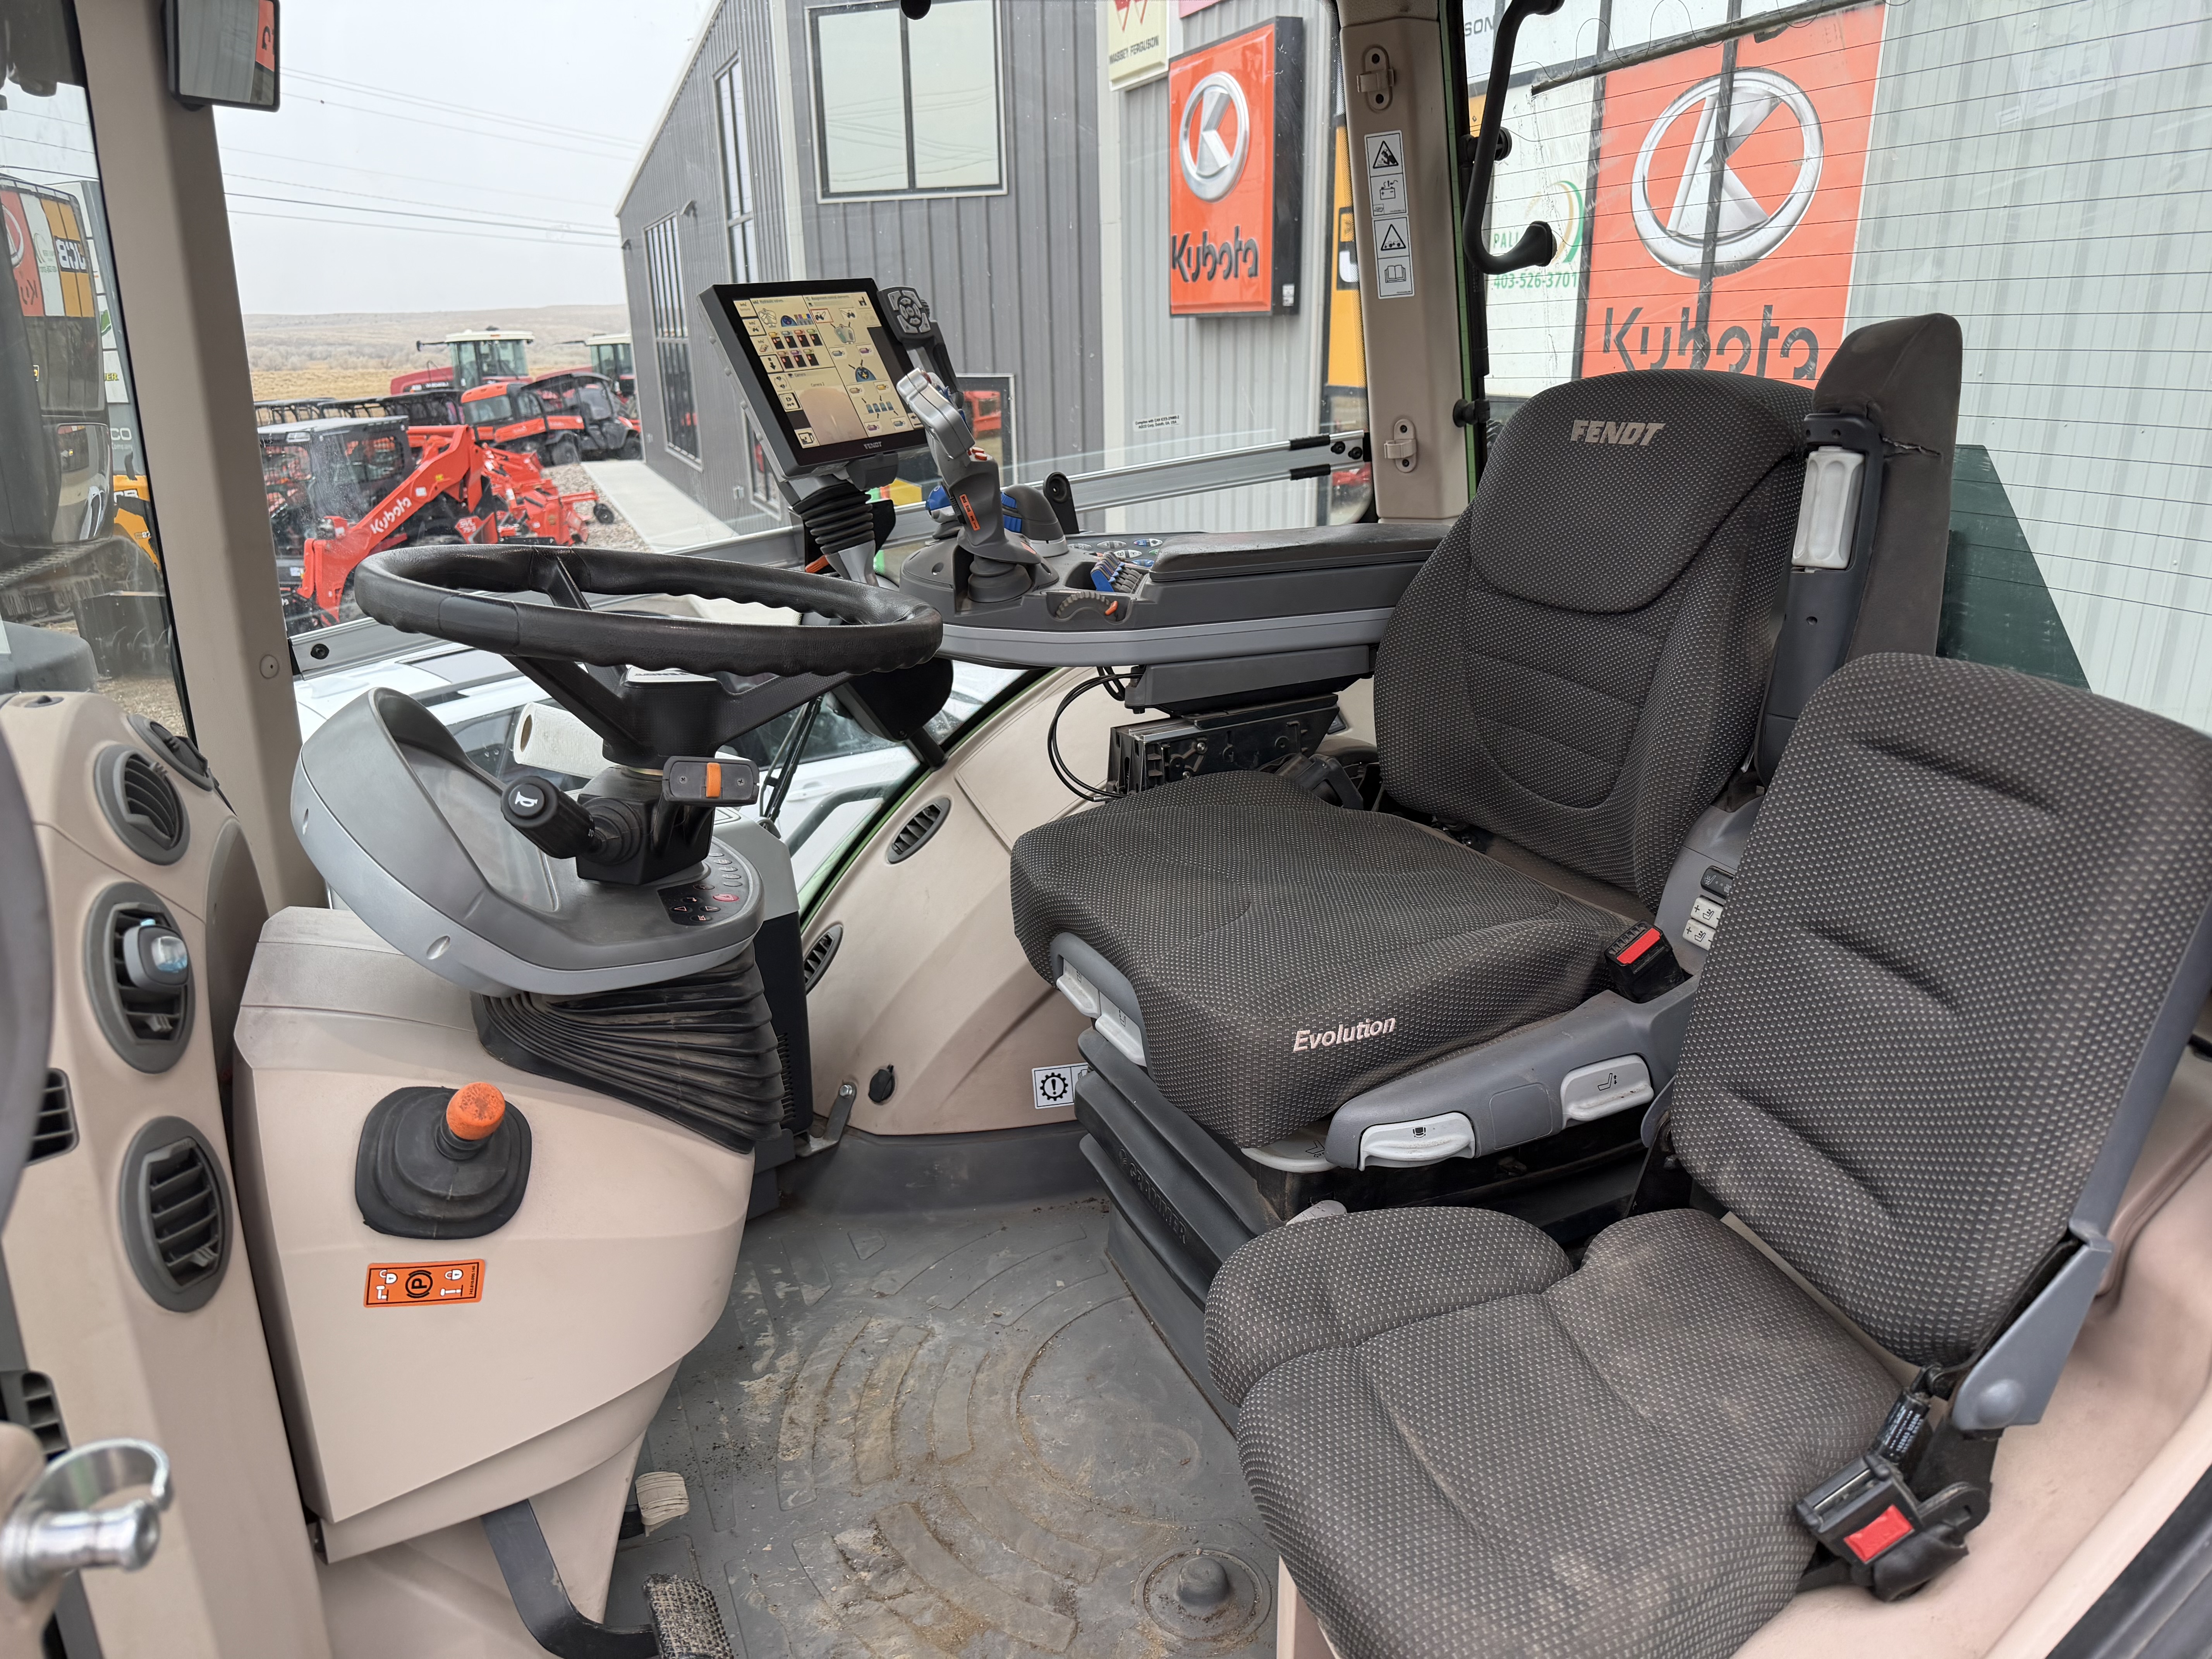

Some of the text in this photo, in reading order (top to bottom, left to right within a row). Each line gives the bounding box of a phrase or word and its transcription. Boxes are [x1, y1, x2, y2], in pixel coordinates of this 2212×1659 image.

[1129, 35, 1159, 56] FERGUSON
[1172, 225, 1259, 283] Kubota
[1494, 272, 1577, 289] 403-526-3701
[1603, 304, 1819, 380] Kubota
[1570, 419, 1666, 446] FENDT
[371, 497, 412, 534] Kubota
[1293, 1018, 1396, 1053] Evolution
